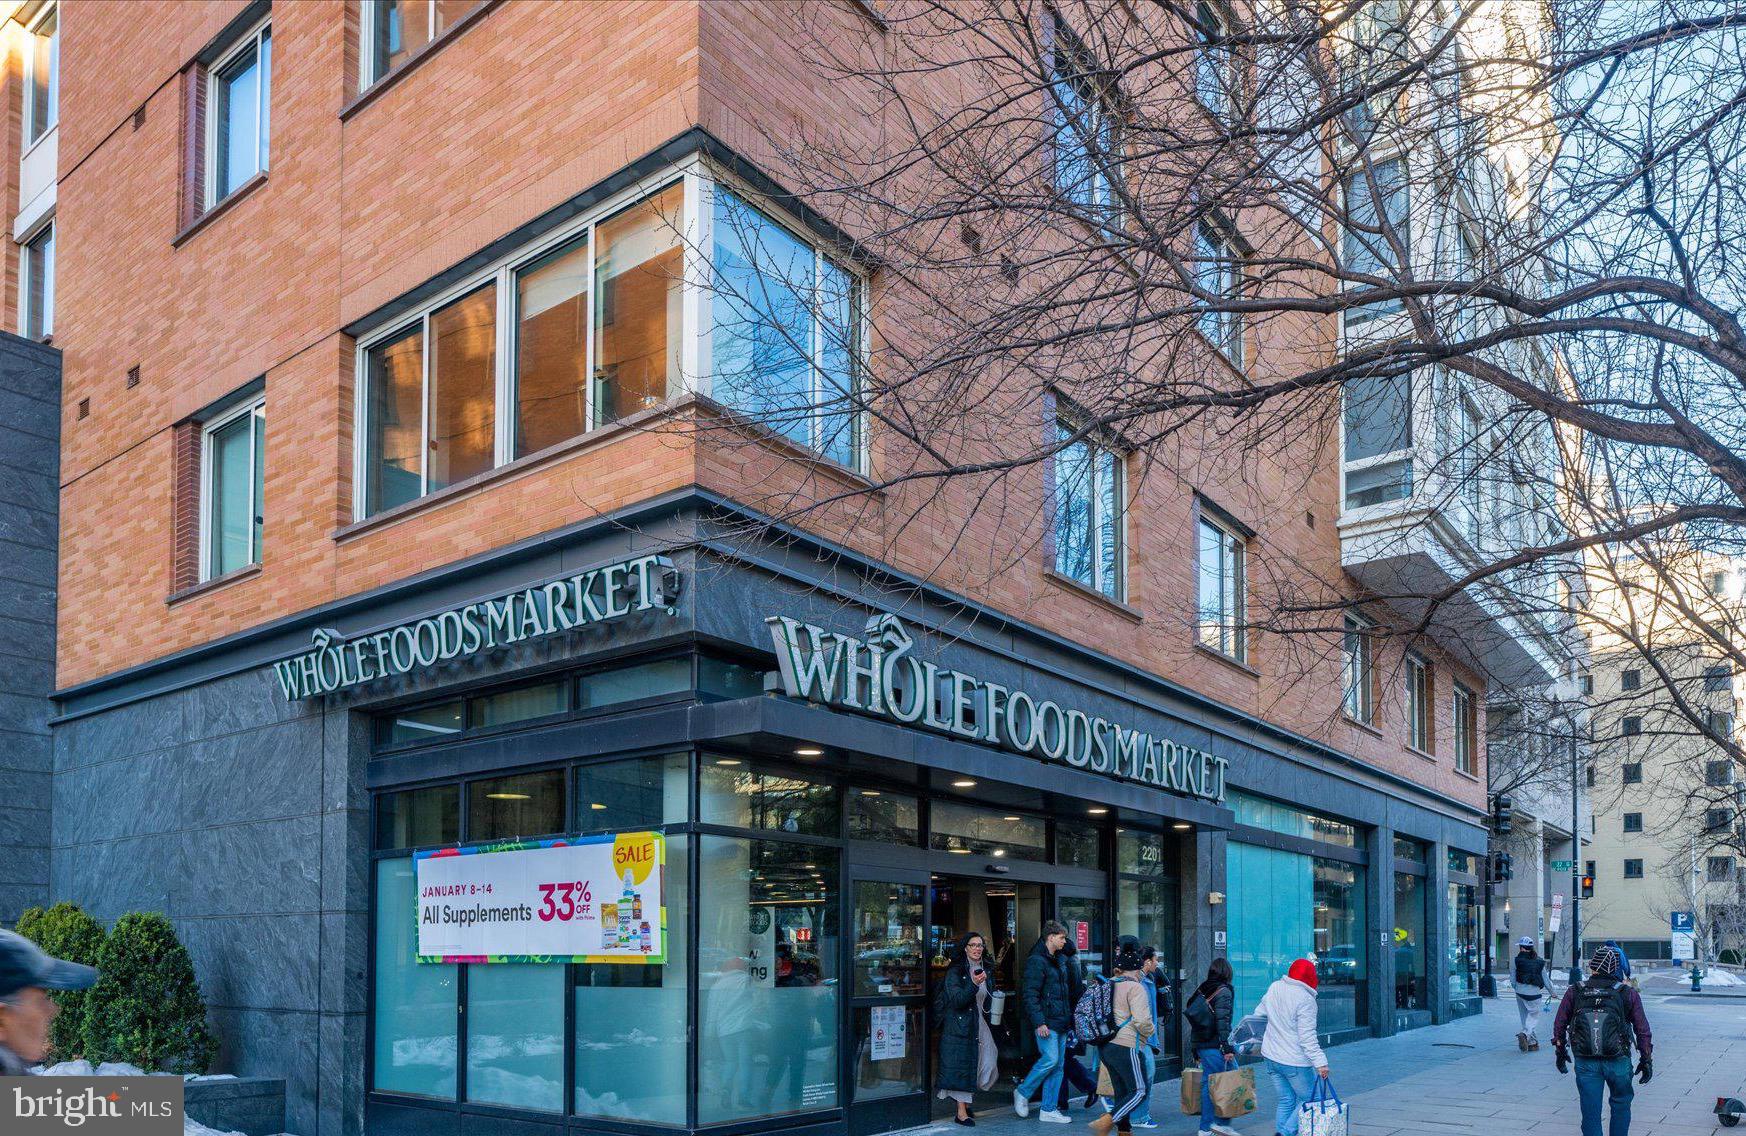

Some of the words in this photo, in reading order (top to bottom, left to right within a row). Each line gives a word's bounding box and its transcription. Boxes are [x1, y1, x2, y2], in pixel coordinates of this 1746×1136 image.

[274, 628, 374, 701] WHOLE
[374, 605, 481, 678] FOODS
[486, 555, 661, 647] MARKET
[764, 613, 980, 738] WHOLE
[982, 681, 1109, 772] FOODS
[1111, 722, 1230, 802] MARKET
[615, 842, 653, 864] SALE
[1142, 845, 1161, 862] 2201
[422, 885, 466, 898] JANUARY
[423, 905, 440, 924] All
[443, 902, 532, 928] Supplements
[576, 904, 591, 914] OFF
